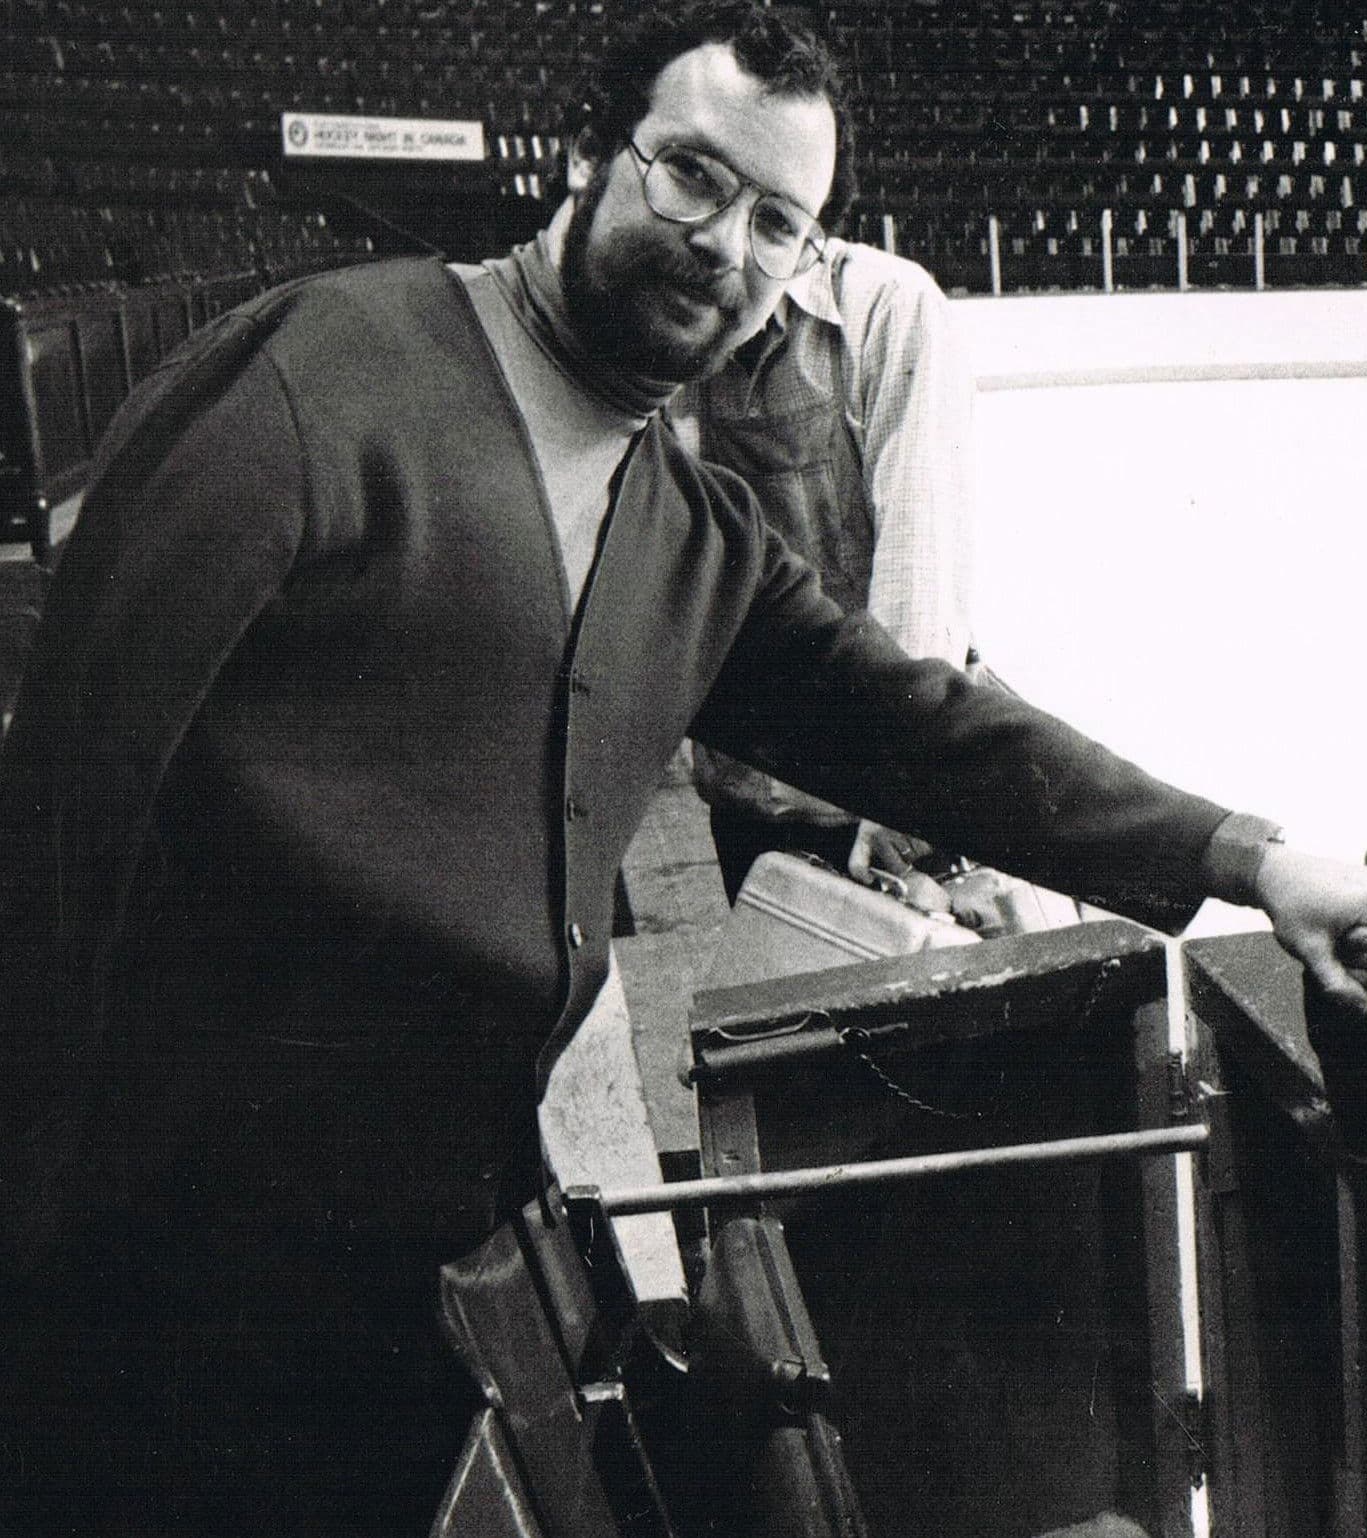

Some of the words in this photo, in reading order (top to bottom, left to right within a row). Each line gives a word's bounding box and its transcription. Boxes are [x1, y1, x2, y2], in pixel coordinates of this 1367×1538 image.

[314, 130, 359, 142] HOCKEY
[363, 131, 397, 143] NIGHT
[403, 133, 414, 144] IN
[420, 133, 466, 146] CANADA
